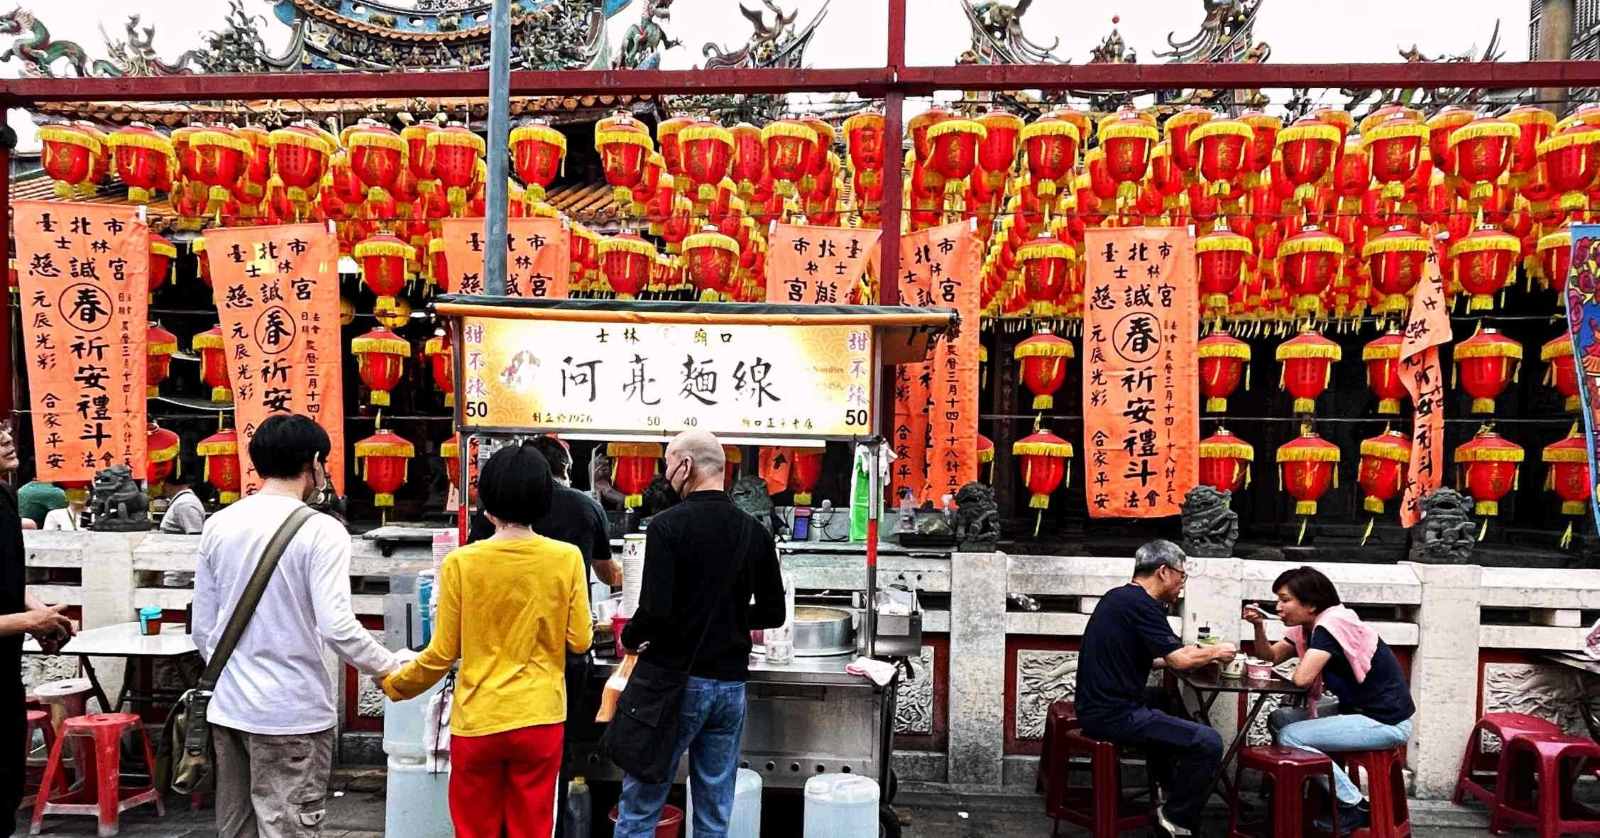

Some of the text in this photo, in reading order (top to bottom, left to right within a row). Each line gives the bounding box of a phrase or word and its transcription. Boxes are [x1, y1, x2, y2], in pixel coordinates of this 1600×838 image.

[1101, 241, 1173, 262] 臺北市
[561, 353, 781, 408] 阿亮麵線
[465, 401, 488, 418] 50
[845, 409, 868, 426] 50
[647, 415, 661, 426] 50
[683, 416, 698, 427] 40
